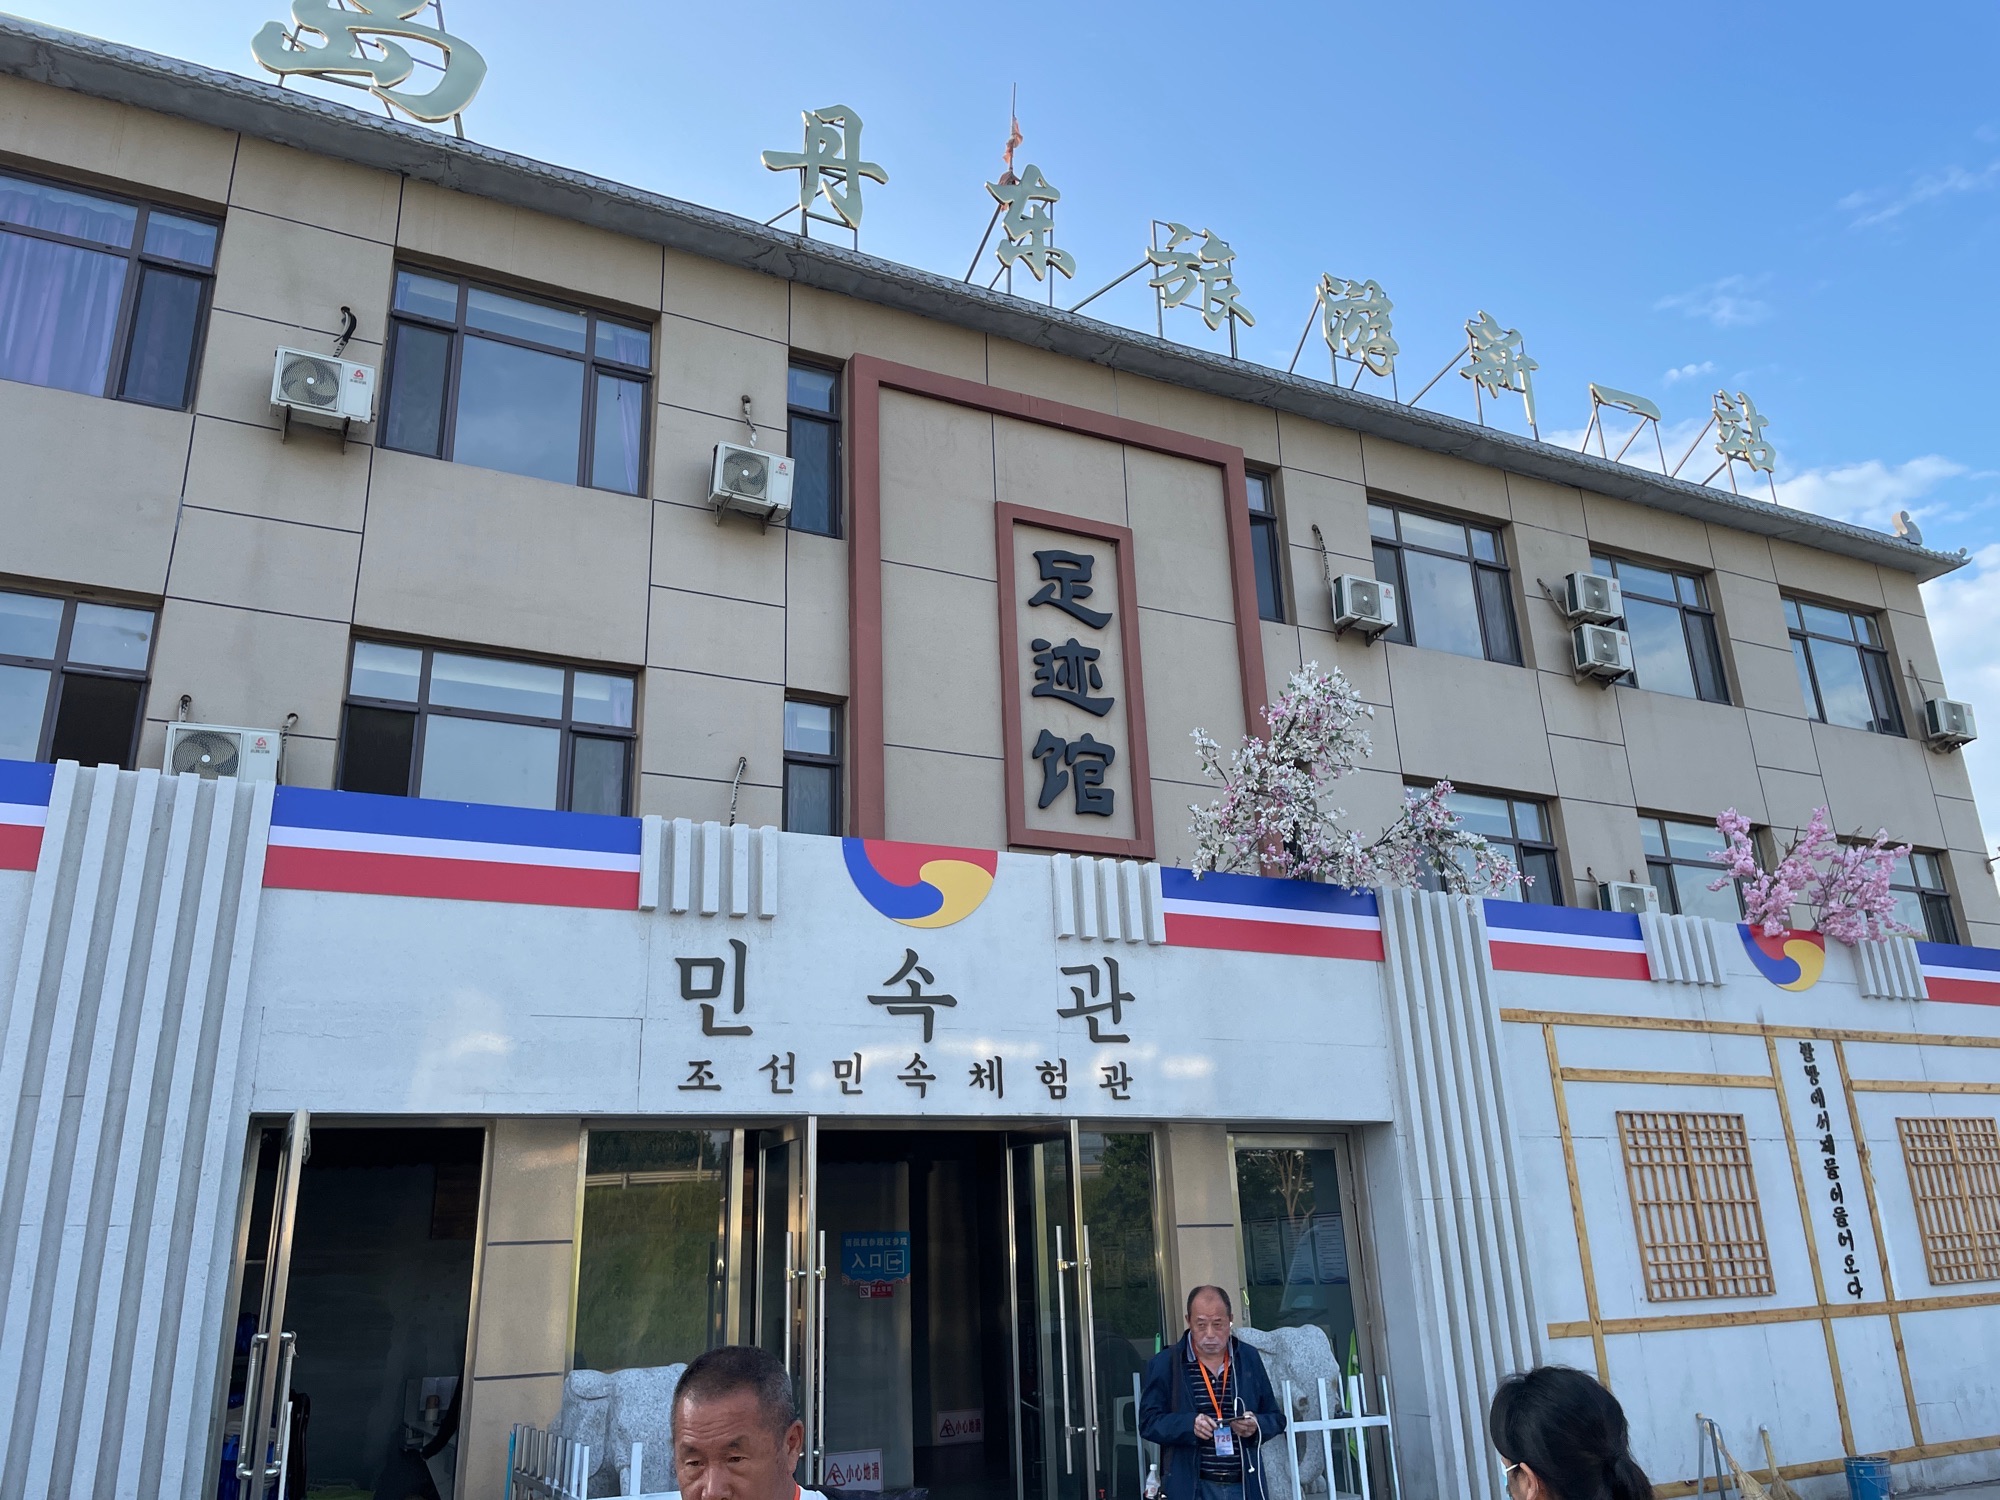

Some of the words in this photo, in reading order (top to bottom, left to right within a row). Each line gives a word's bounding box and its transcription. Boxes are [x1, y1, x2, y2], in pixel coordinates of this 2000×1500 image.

[761, 104, 1776, 473] 丹东旅游新一站
[1028, 550, 1115, 817] 足迹馆
[675, 938, 1136, 1043] 민속관
[677, 1052, 1134, 1100] 조선민속체험관
[851, 1253, 881, 1268] 入口
[955, 1420, 981, 1434] 小心地滑
[1215, 1434, 1231, 1443] 726
[846, 1461, 880, 1482] 小心地滑
